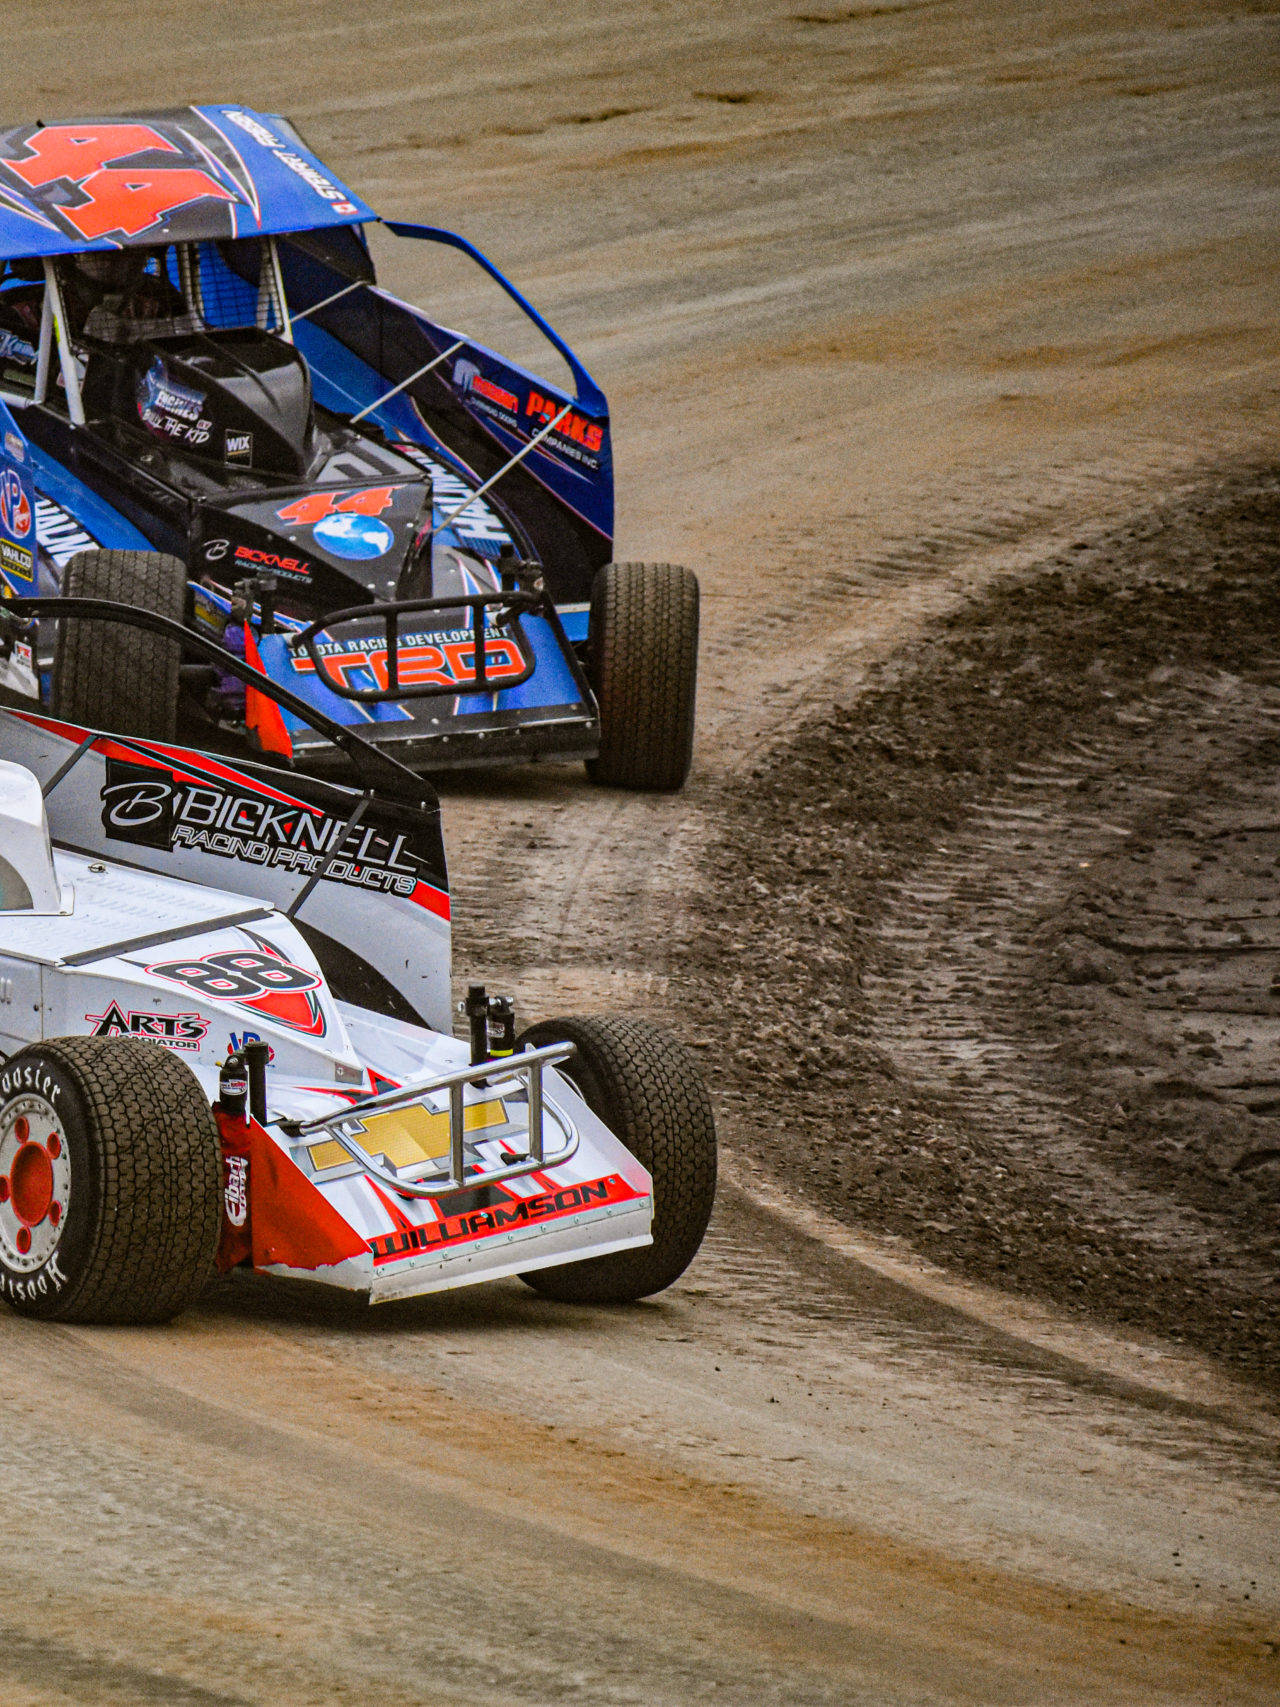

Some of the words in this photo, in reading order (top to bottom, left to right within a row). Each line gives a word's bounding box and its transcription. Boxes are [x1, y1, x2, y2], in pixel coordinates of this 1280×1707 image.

[184, 427, 210, 444] KID
[226, 435, 251, 452] WIX
[531, 427, 582, 460] CMPANIES
[276, 485, 398, 526] 44
[234, 545, 311, 575] BICKNELL
[288, 640, 344, 659] TOOTA
[290, 638, 527, 692] TRD
[172, 826, 267, 860] RACING
[180, 787, 418, 872] BICKNELL
[150, 951, 317, 999] 88
[371, 1180, 609, 1258] WILLIAMSON
